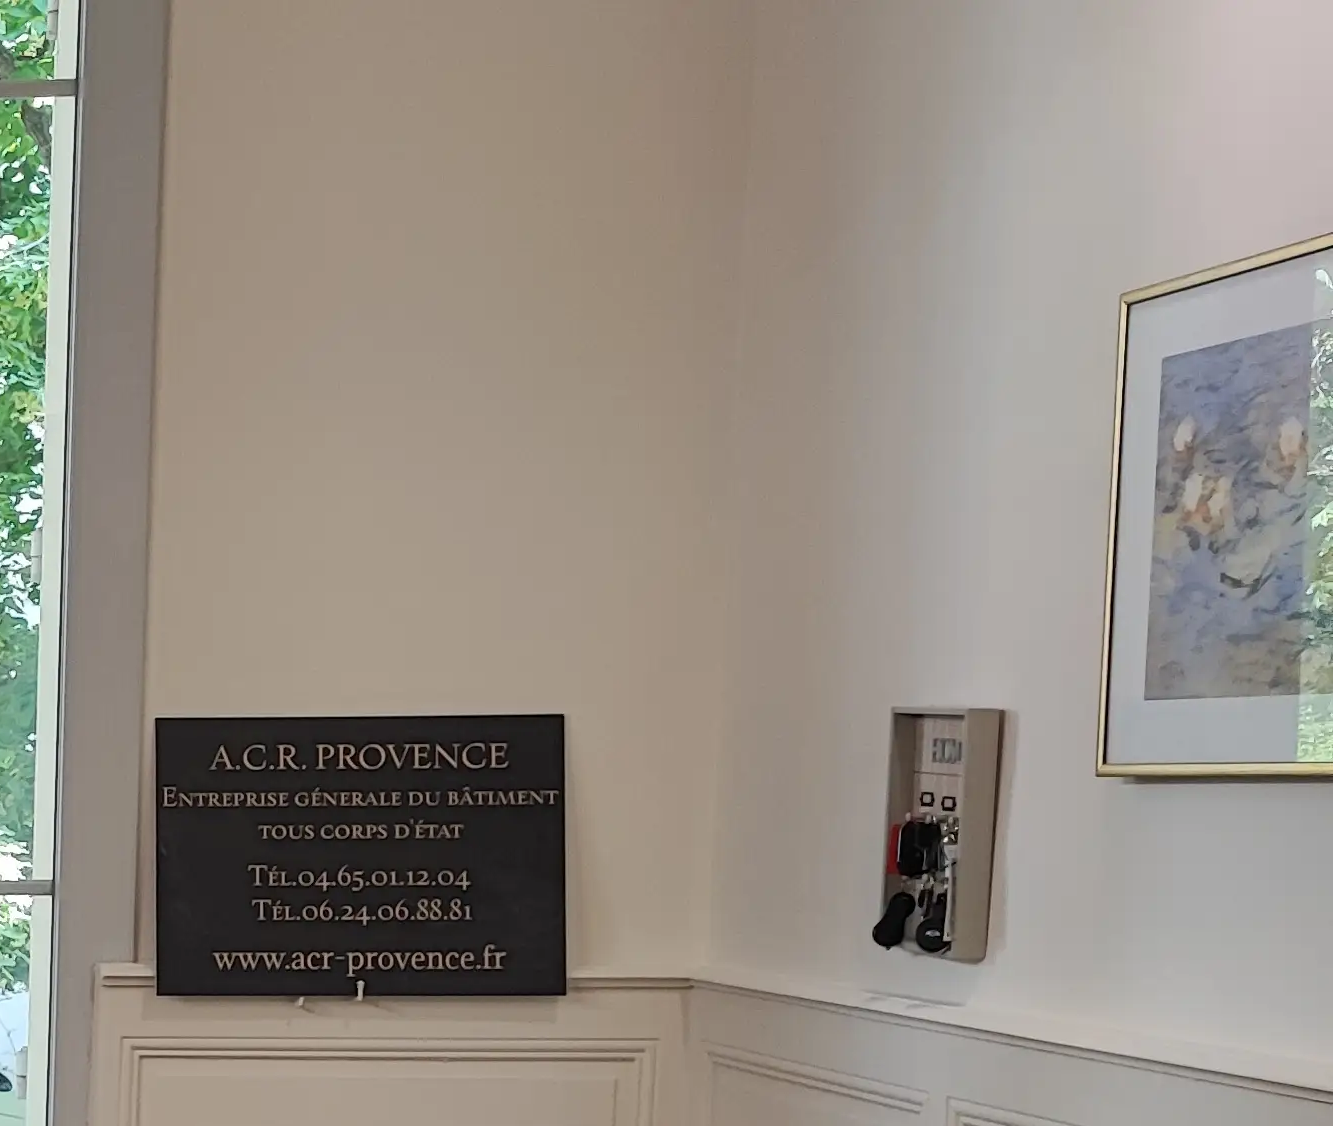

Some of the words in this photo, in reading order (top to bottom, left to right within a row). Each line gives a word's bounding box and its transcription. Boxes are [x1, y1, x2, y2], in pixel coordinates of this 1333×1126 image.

[209, 744, 307, 771] A.C.R.
[315, 742, 510, 770] PROVENCE
[407, 790, 439, 806] DU
[446, 786, 559, 806] BÂTIMENT
[258, 823, 315, 840] TOUS
[320, 823, 387, 840] CORPS
[394, 818, 464, 840] D'ÉTAT
[213, 944, 506, 977] www.acr-provence.fr
